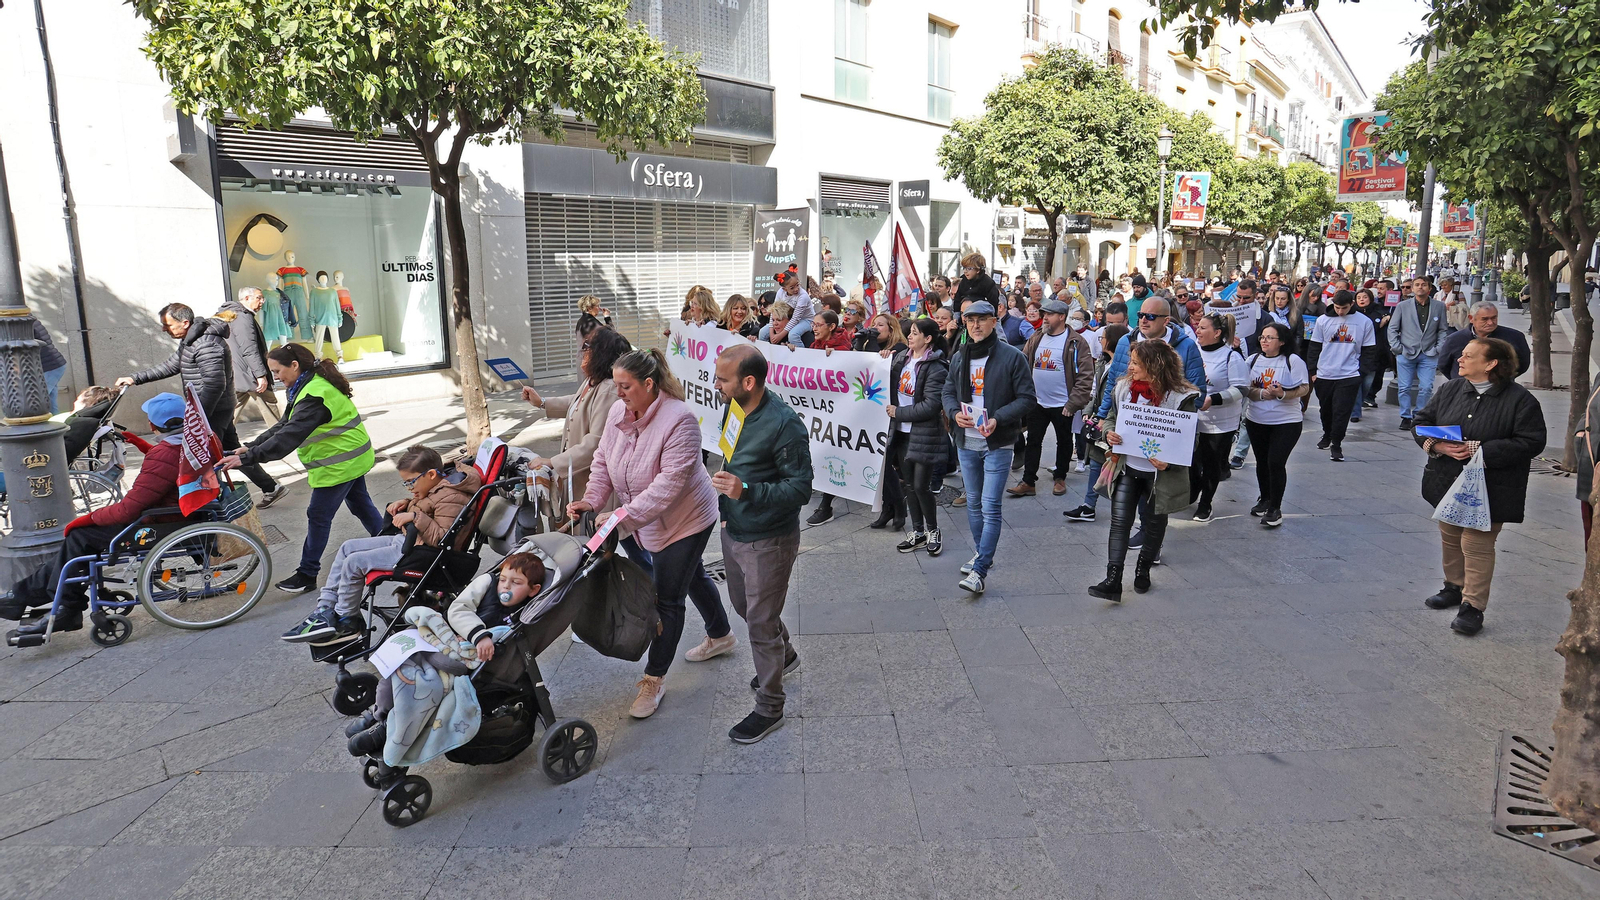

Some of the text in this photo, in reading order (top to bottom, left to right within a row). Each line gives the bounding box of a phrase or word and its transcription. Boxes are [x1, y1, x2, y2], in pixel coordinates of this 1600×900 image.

[271, 168, 396, 183] www.sfera.com
[1347, 177, 1395, 192] 27 Festival
[1175, 211, 1184, 220] 27
[764, 253, 797, 264] UNIPER
[406, 270, 435, 283] DÍAS
[687, 338, 708, 361] NO
[698, 369, 709, 382] 28
[766, 360, 850, 394] NVISIBLES
[789, 395, 809, 408] DE
[811, 397, 834, 414] LAS
[1122, 404, 1142, 412] SOMOS
[1152, 409, 1191, 420] ASOCIACIÓN
[1124, 420, 1182, 434] QUILOMICRONEMIA
[1144, 415, 1176, 426] SINDROME
[809, 416, 888, 456] RARAS
[1137, 429, 1166, 439] FAMILIAR
[186, 435, 210, 465] VIVIENDO
[34, 518, 59, 530] 1832
